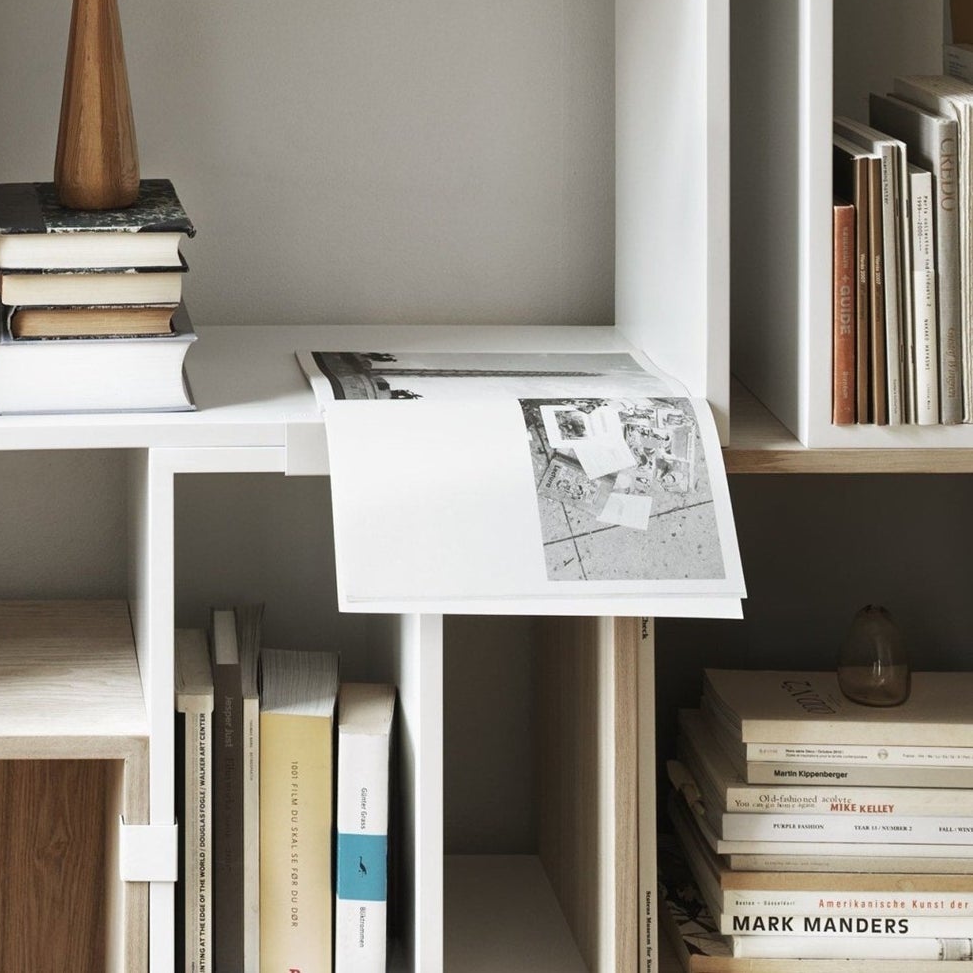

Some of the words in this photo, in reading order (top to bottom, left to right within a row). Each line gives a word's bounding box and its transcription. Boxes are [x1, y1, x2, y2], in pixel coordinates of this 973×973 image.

[940, 138, 956, 212] CREDO
[840, 285, 850, 335] GUIDE
[545, 465, 560, 488] Lecture
[289, 760, 298, 778] 1001
[774, 769, 798, 778] Martin
[798, 770, 848, 779] Kippenberger
[290, 783, 298, 806] FILM
[758, 794, 818, 804] Old-fashioned
[734, 800, 750, 808] You
[830, 804, 856, 812] MIKE
[859, 804, 895, 814] KELLEY
[290, 809, 298, 824] DU
[290, 828, 298, 848] SKAL
[290, 853, 298, 864] SE
[290, 868, 298, 886] FØR
[199, 894, 205, 903] OF
[290, 890, 298, 904] DU
[818, 899, 906, 909] Amerikanische
[912, 900, 944, 909] Kunst
[950, 900, 970, 909] der
[290, 907, 298, 928] DØR
[732, 916, 794, 932] MARK
[804, 917, 909, 934] MANDERS
[199, 938, 205, 946] AT
